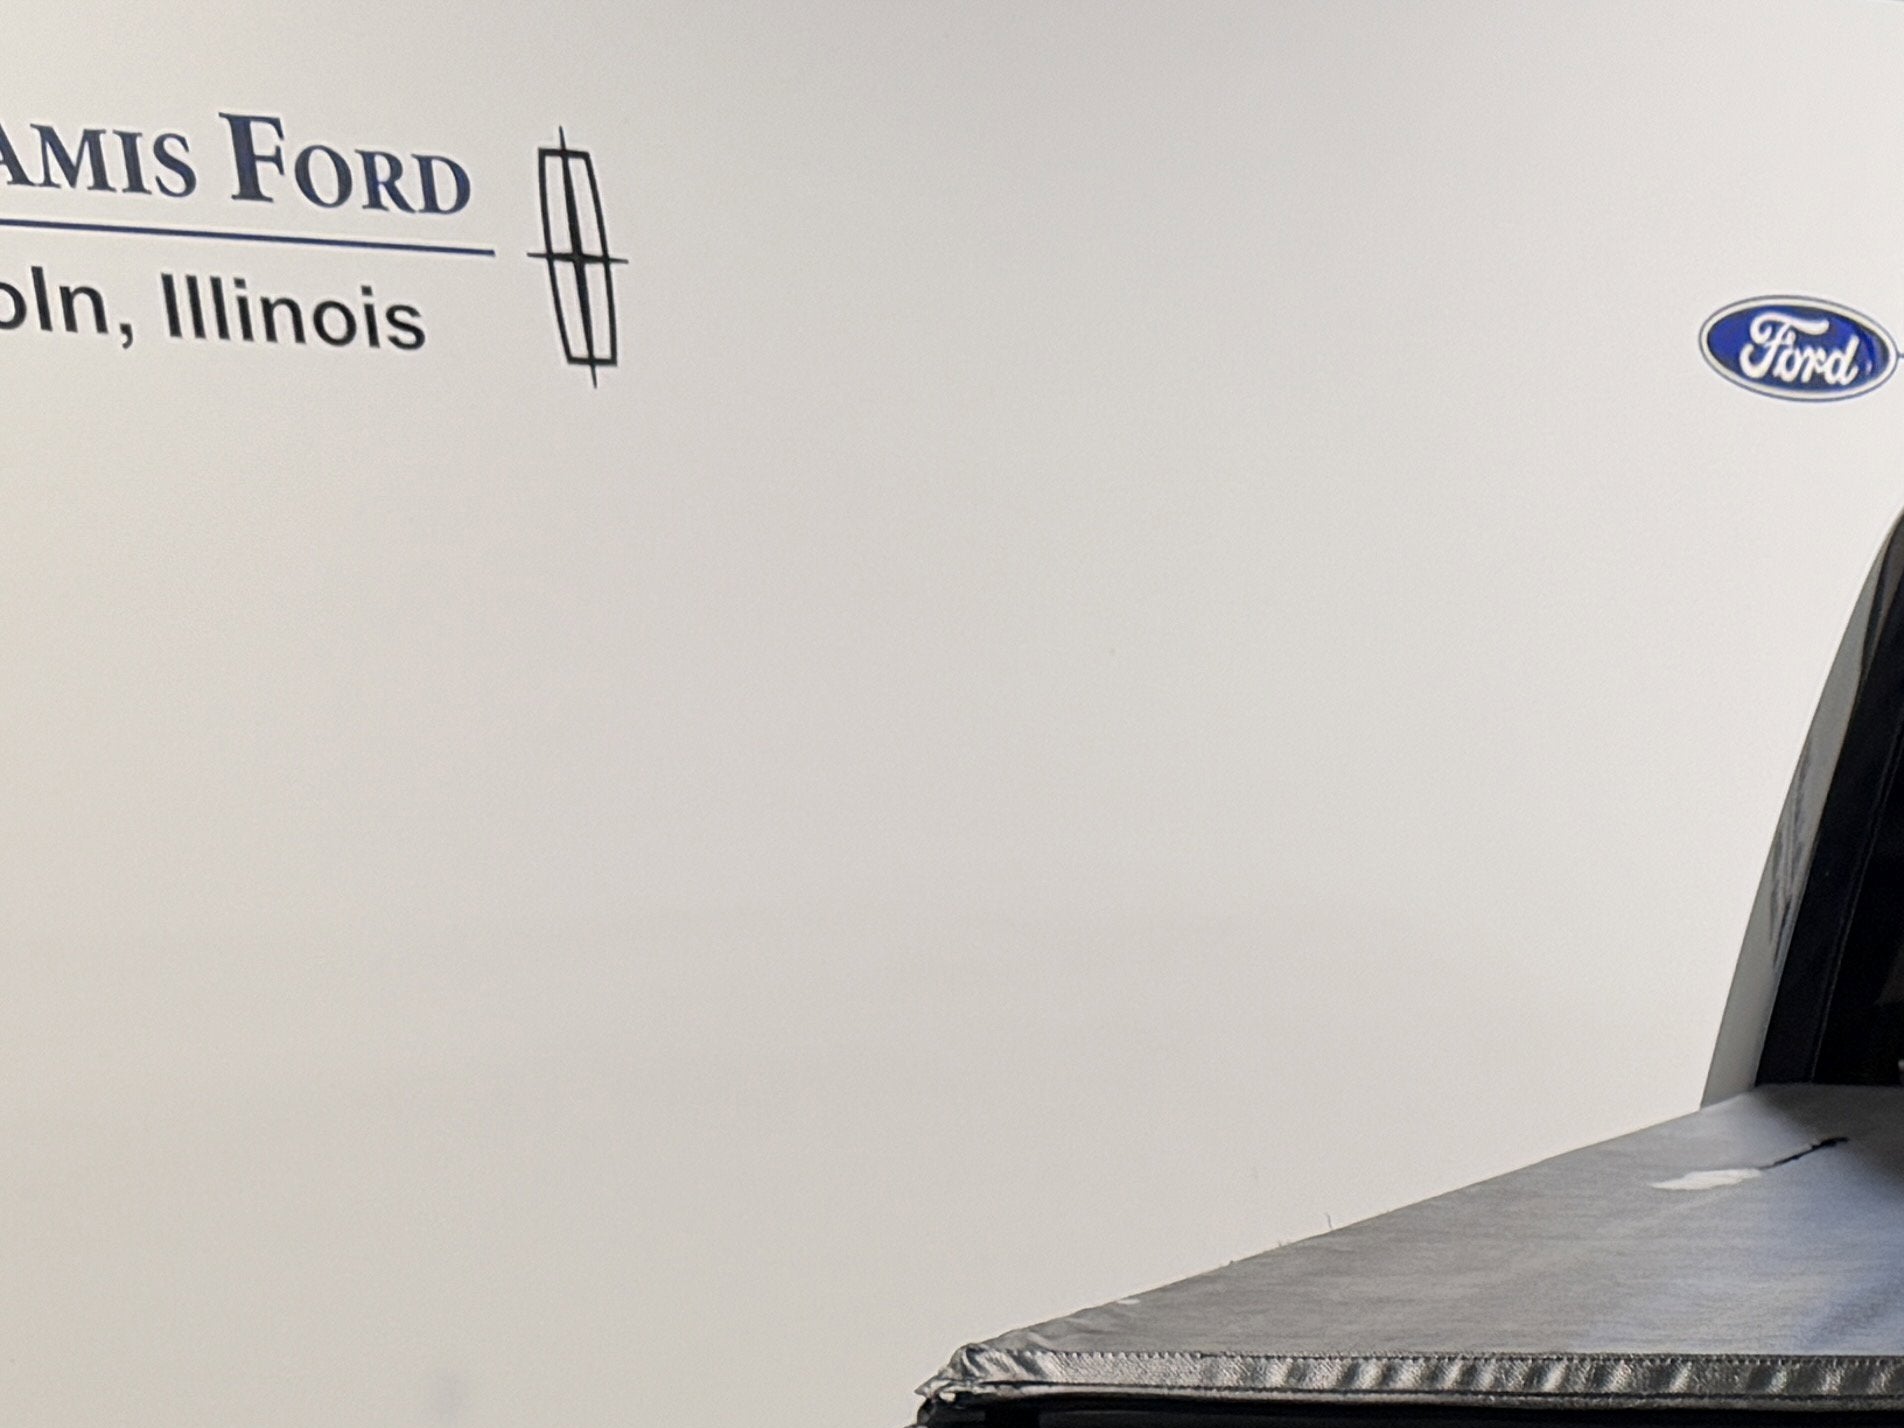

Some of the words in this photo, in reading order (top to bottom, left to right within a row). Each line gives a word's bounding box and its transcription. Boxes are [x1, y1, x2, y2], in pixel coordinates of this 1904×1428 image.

[219, 111, 471, 215] FORD
[161, 271, 426, 351] Illinois
[1738, 311, 1859, 386] Ford
